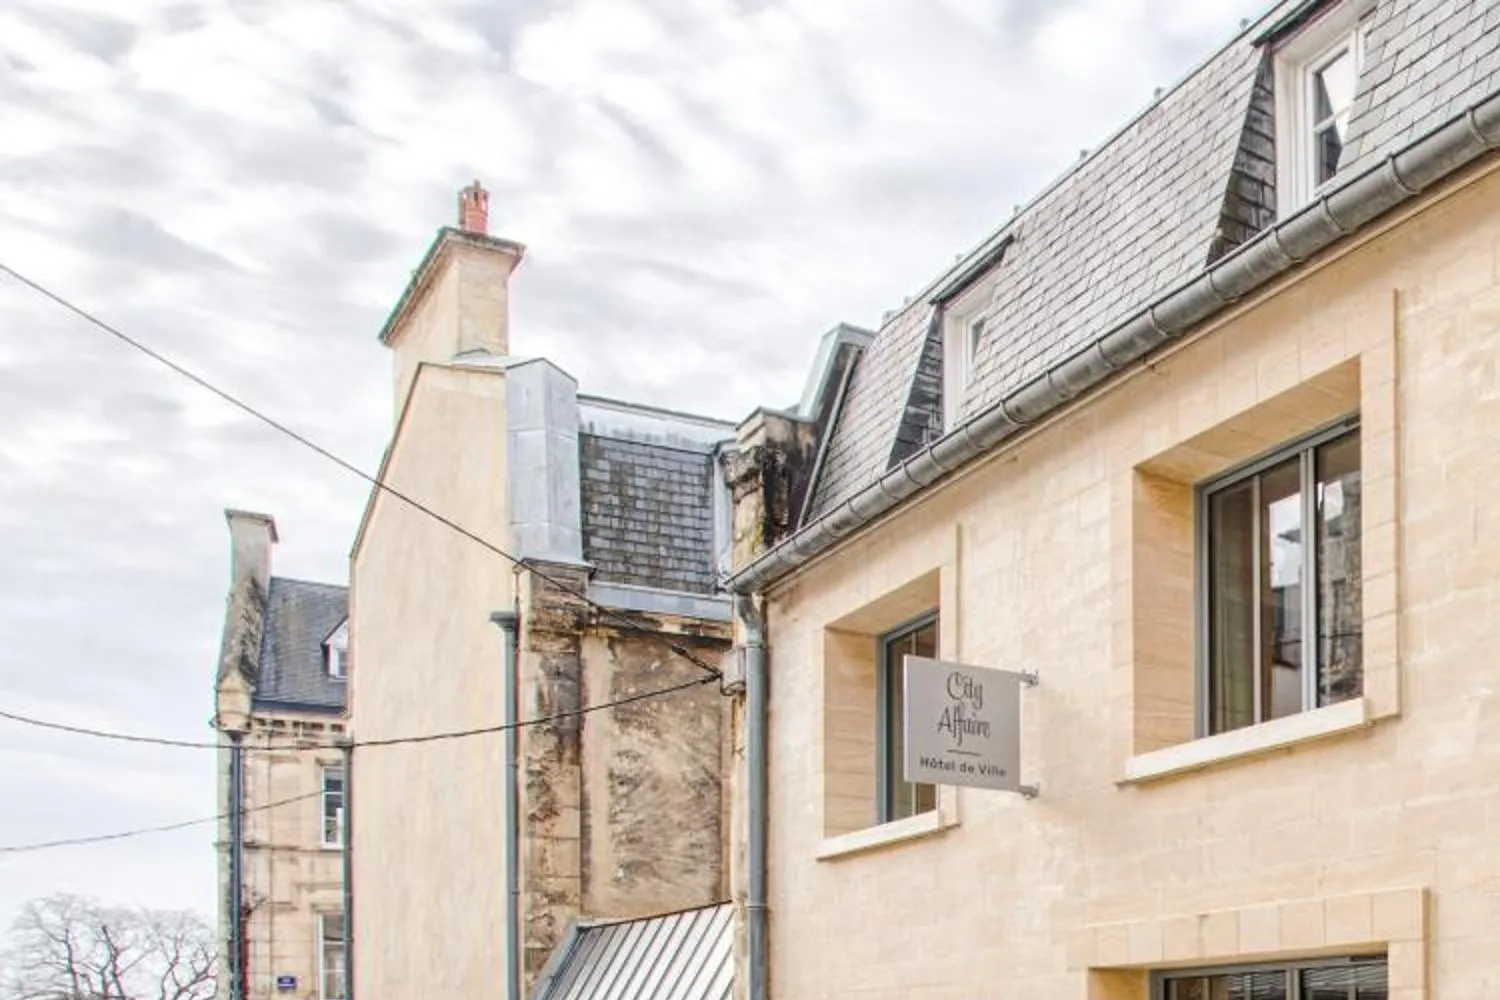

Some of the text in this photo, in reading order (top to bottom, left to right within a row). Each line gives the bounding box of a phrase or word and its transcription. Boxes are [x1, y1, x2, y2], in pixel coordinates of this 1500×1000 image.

[946, 671, 984, 710] City
[919, 756, 1008, 778] Hôtel de Ville
